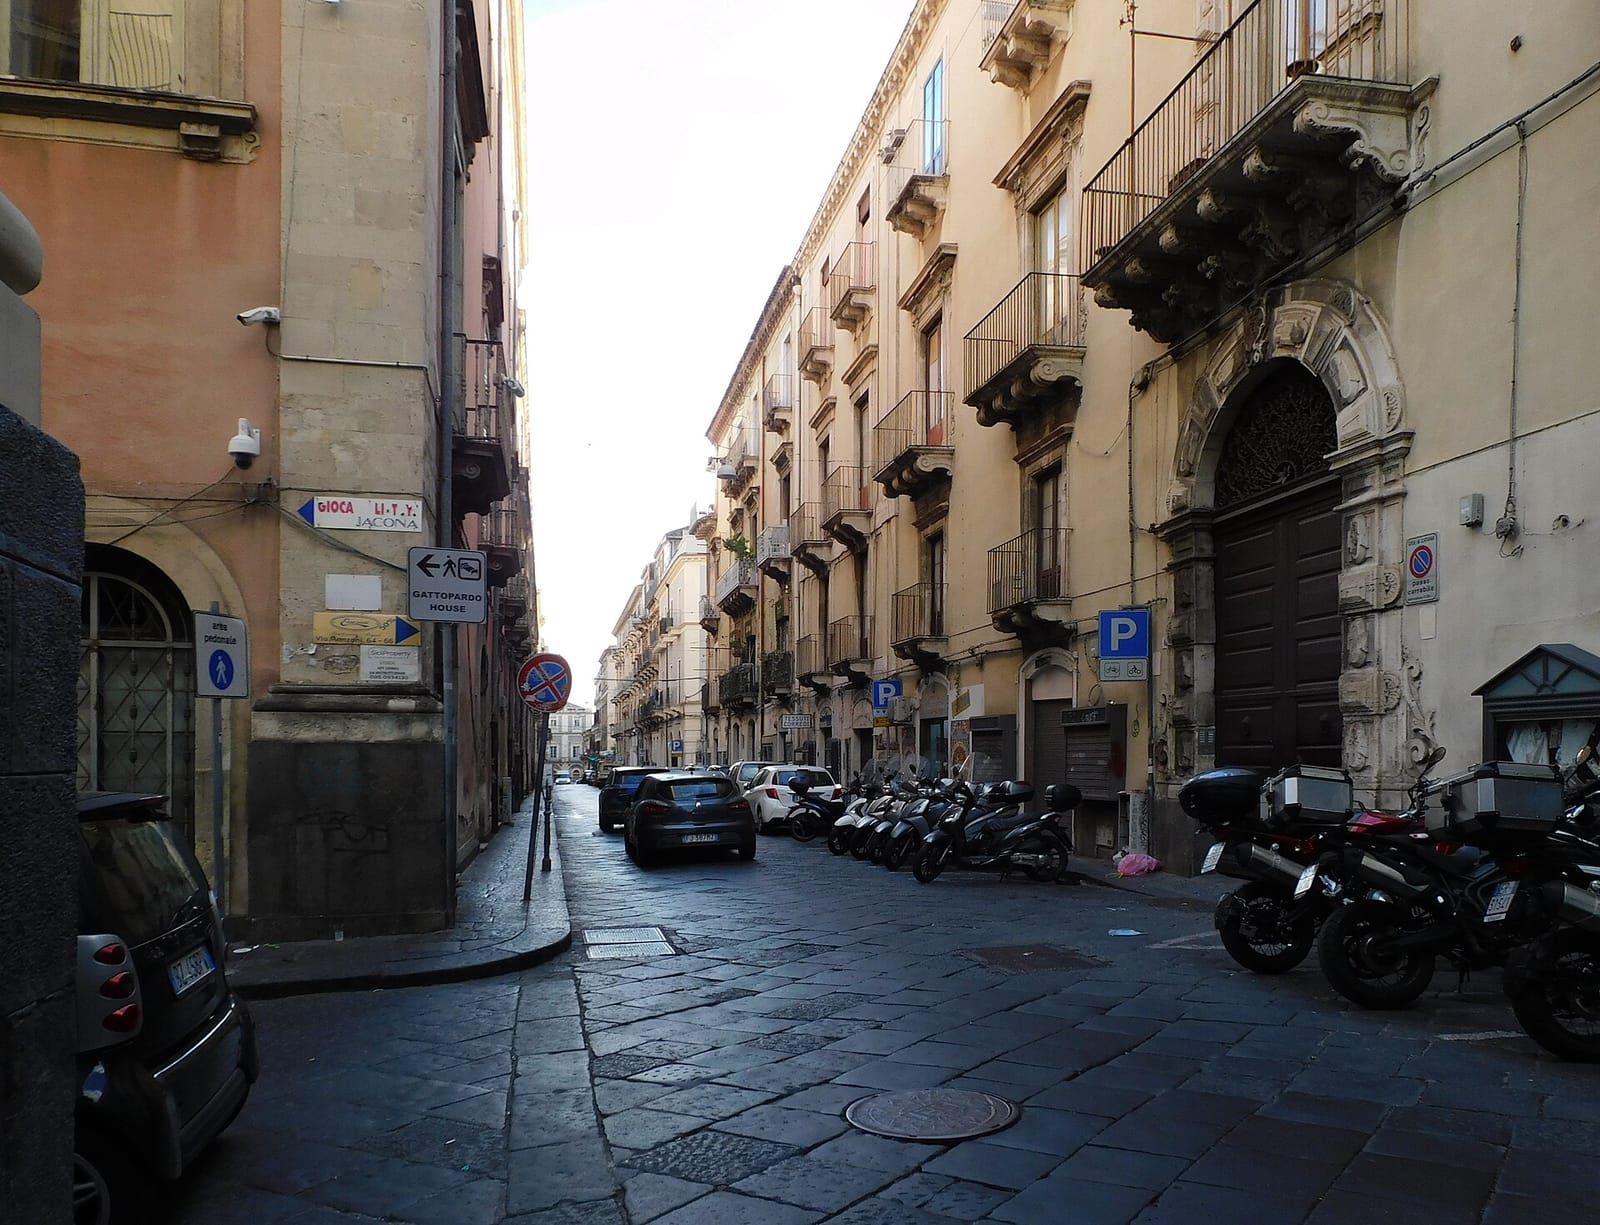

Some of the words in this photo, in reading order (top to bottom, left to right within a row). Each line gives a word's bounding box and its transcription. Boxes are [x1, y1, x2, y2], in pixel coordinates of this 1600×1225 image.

[317, 500, 354, 514] GIOCA
[356, 516, 418, 529] JACONA
[1412, 579, 1430, 587] passo
[412, 590, 482, 602] GATTOPARDO
[1407, 585, 1434, 596] carrabile
[430, 603, 466, 613] HOUSE
[212, 622, 228, 631] area
[204, 634, 237, 645] pedonale
[1110, 617, 1137, 651] P
[878, 683, 896, 705] P
[673, 741, 681, 751] P
